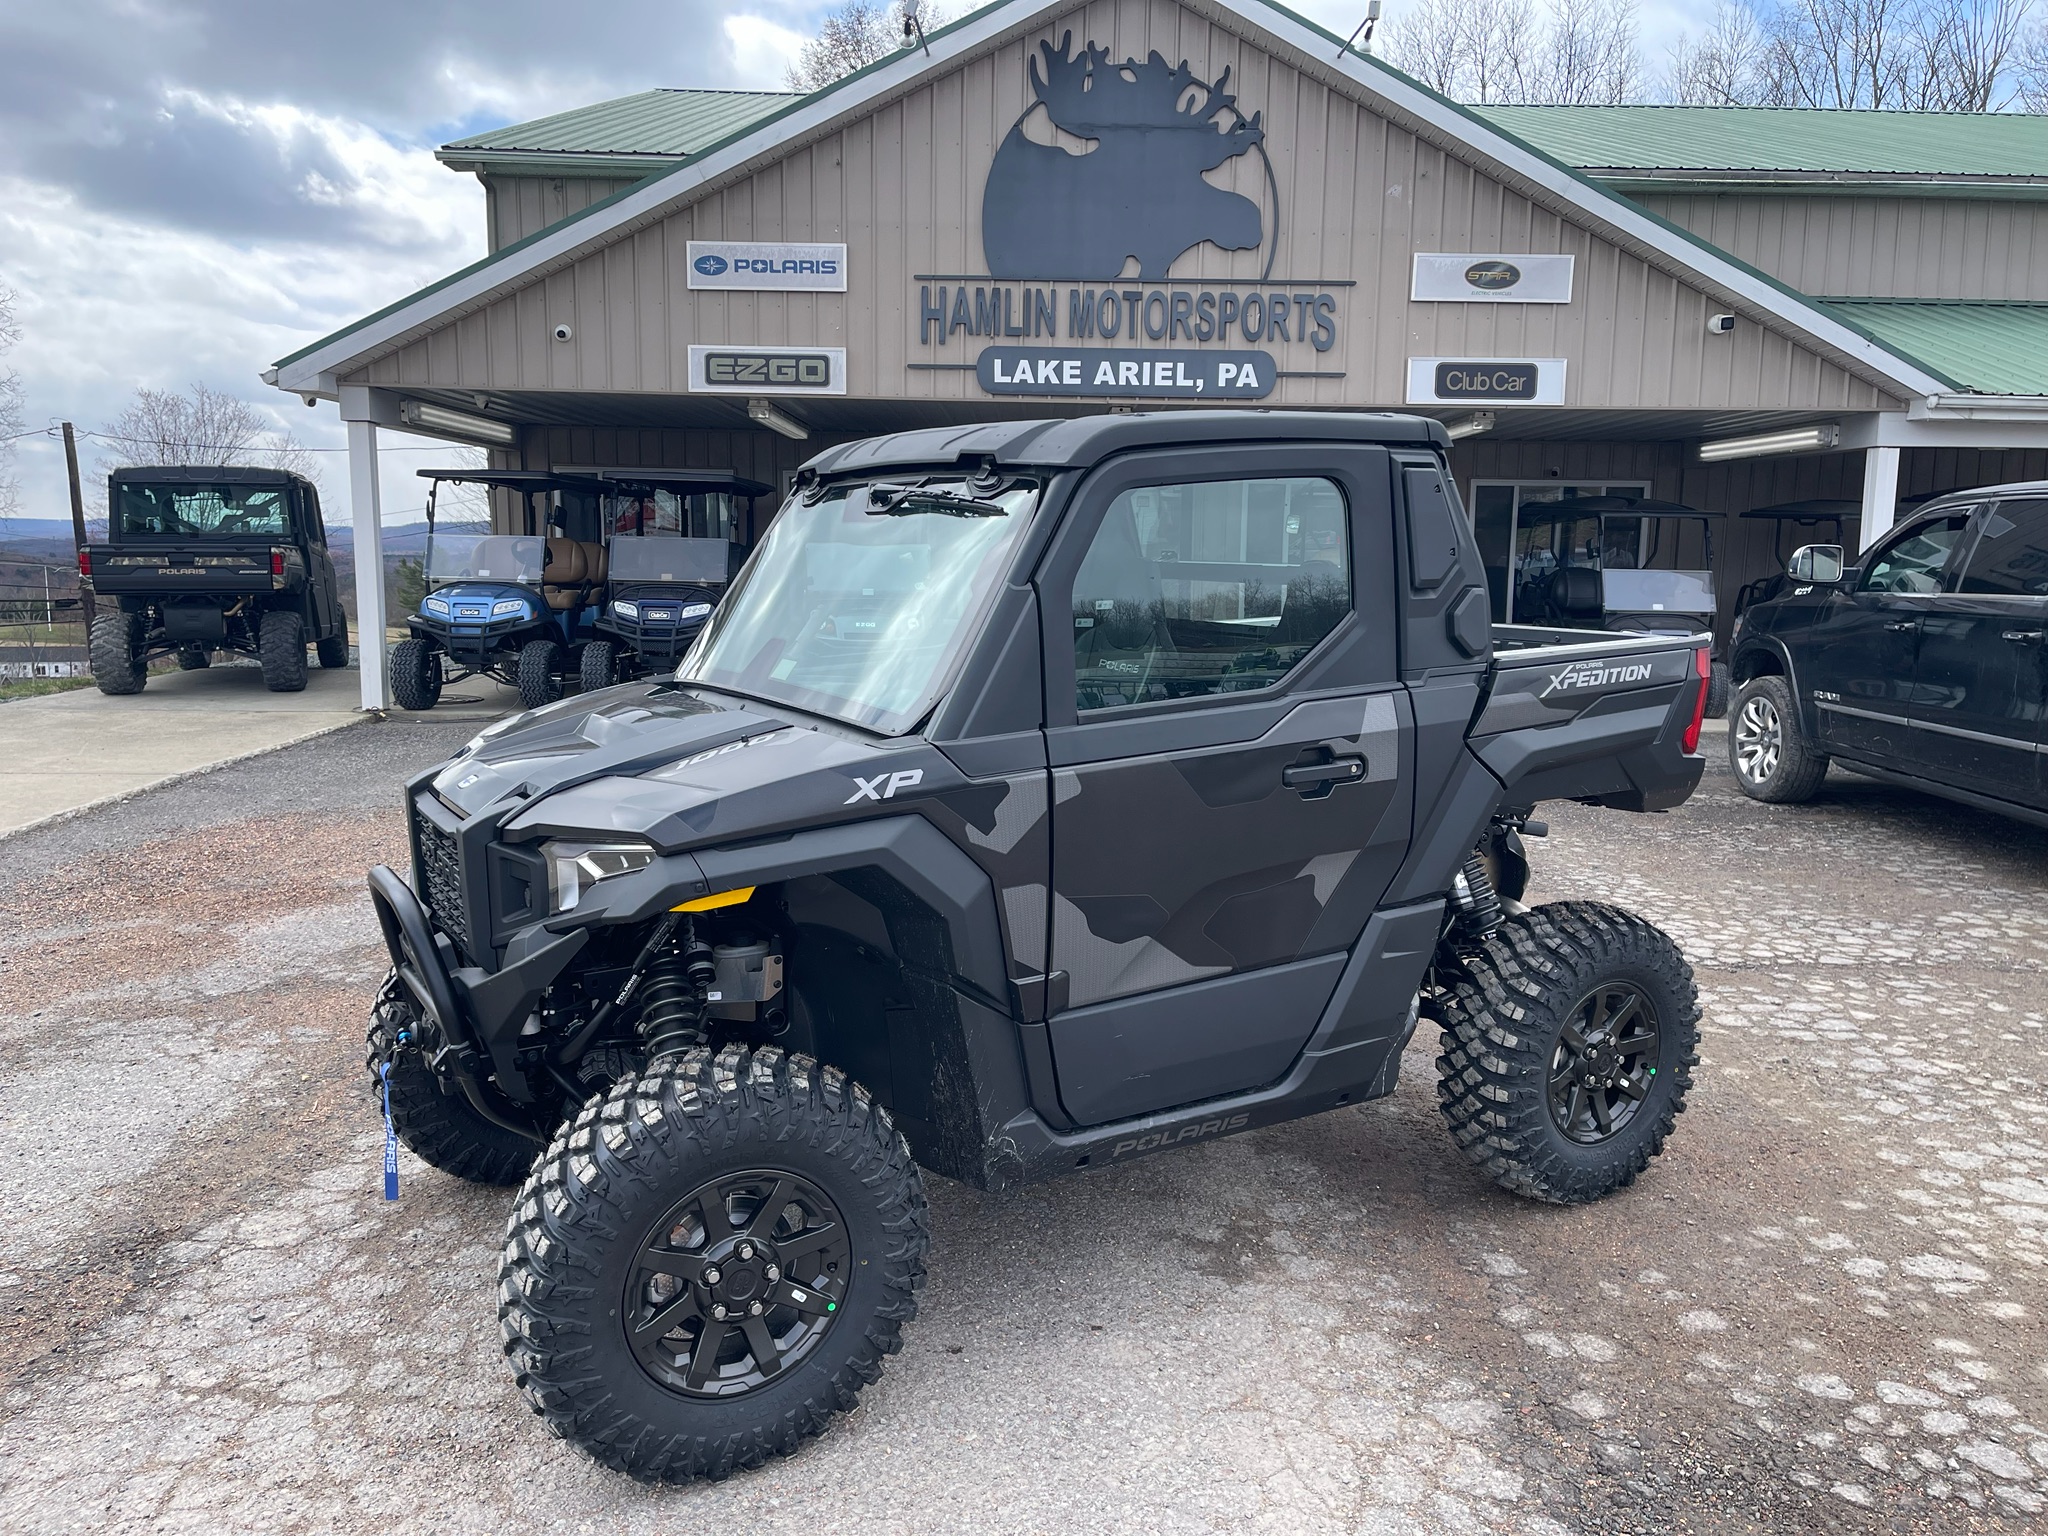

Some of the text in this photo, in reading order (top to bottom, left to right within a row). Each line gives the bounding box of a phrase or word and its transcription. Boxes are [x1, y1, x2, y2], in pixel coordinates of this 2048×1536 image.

[734, 259, 837, 275] POLARIS
[920, 285, 1337, 352] HAMLIN MOTORSPORTS
[993, 358, 1259, 393] LAKE ARIEL, PA
[1099, 659, 1140, 674] POLARIS
[1539, 664, 1653, 699] XPEDITION
[1813, 690, 1840, 701] RAM
[843, 768, 924, 805] XP
[385, 1113, 397, 1174] POLARIS
[1112, 1113, 1250, 1158] POLARIS
